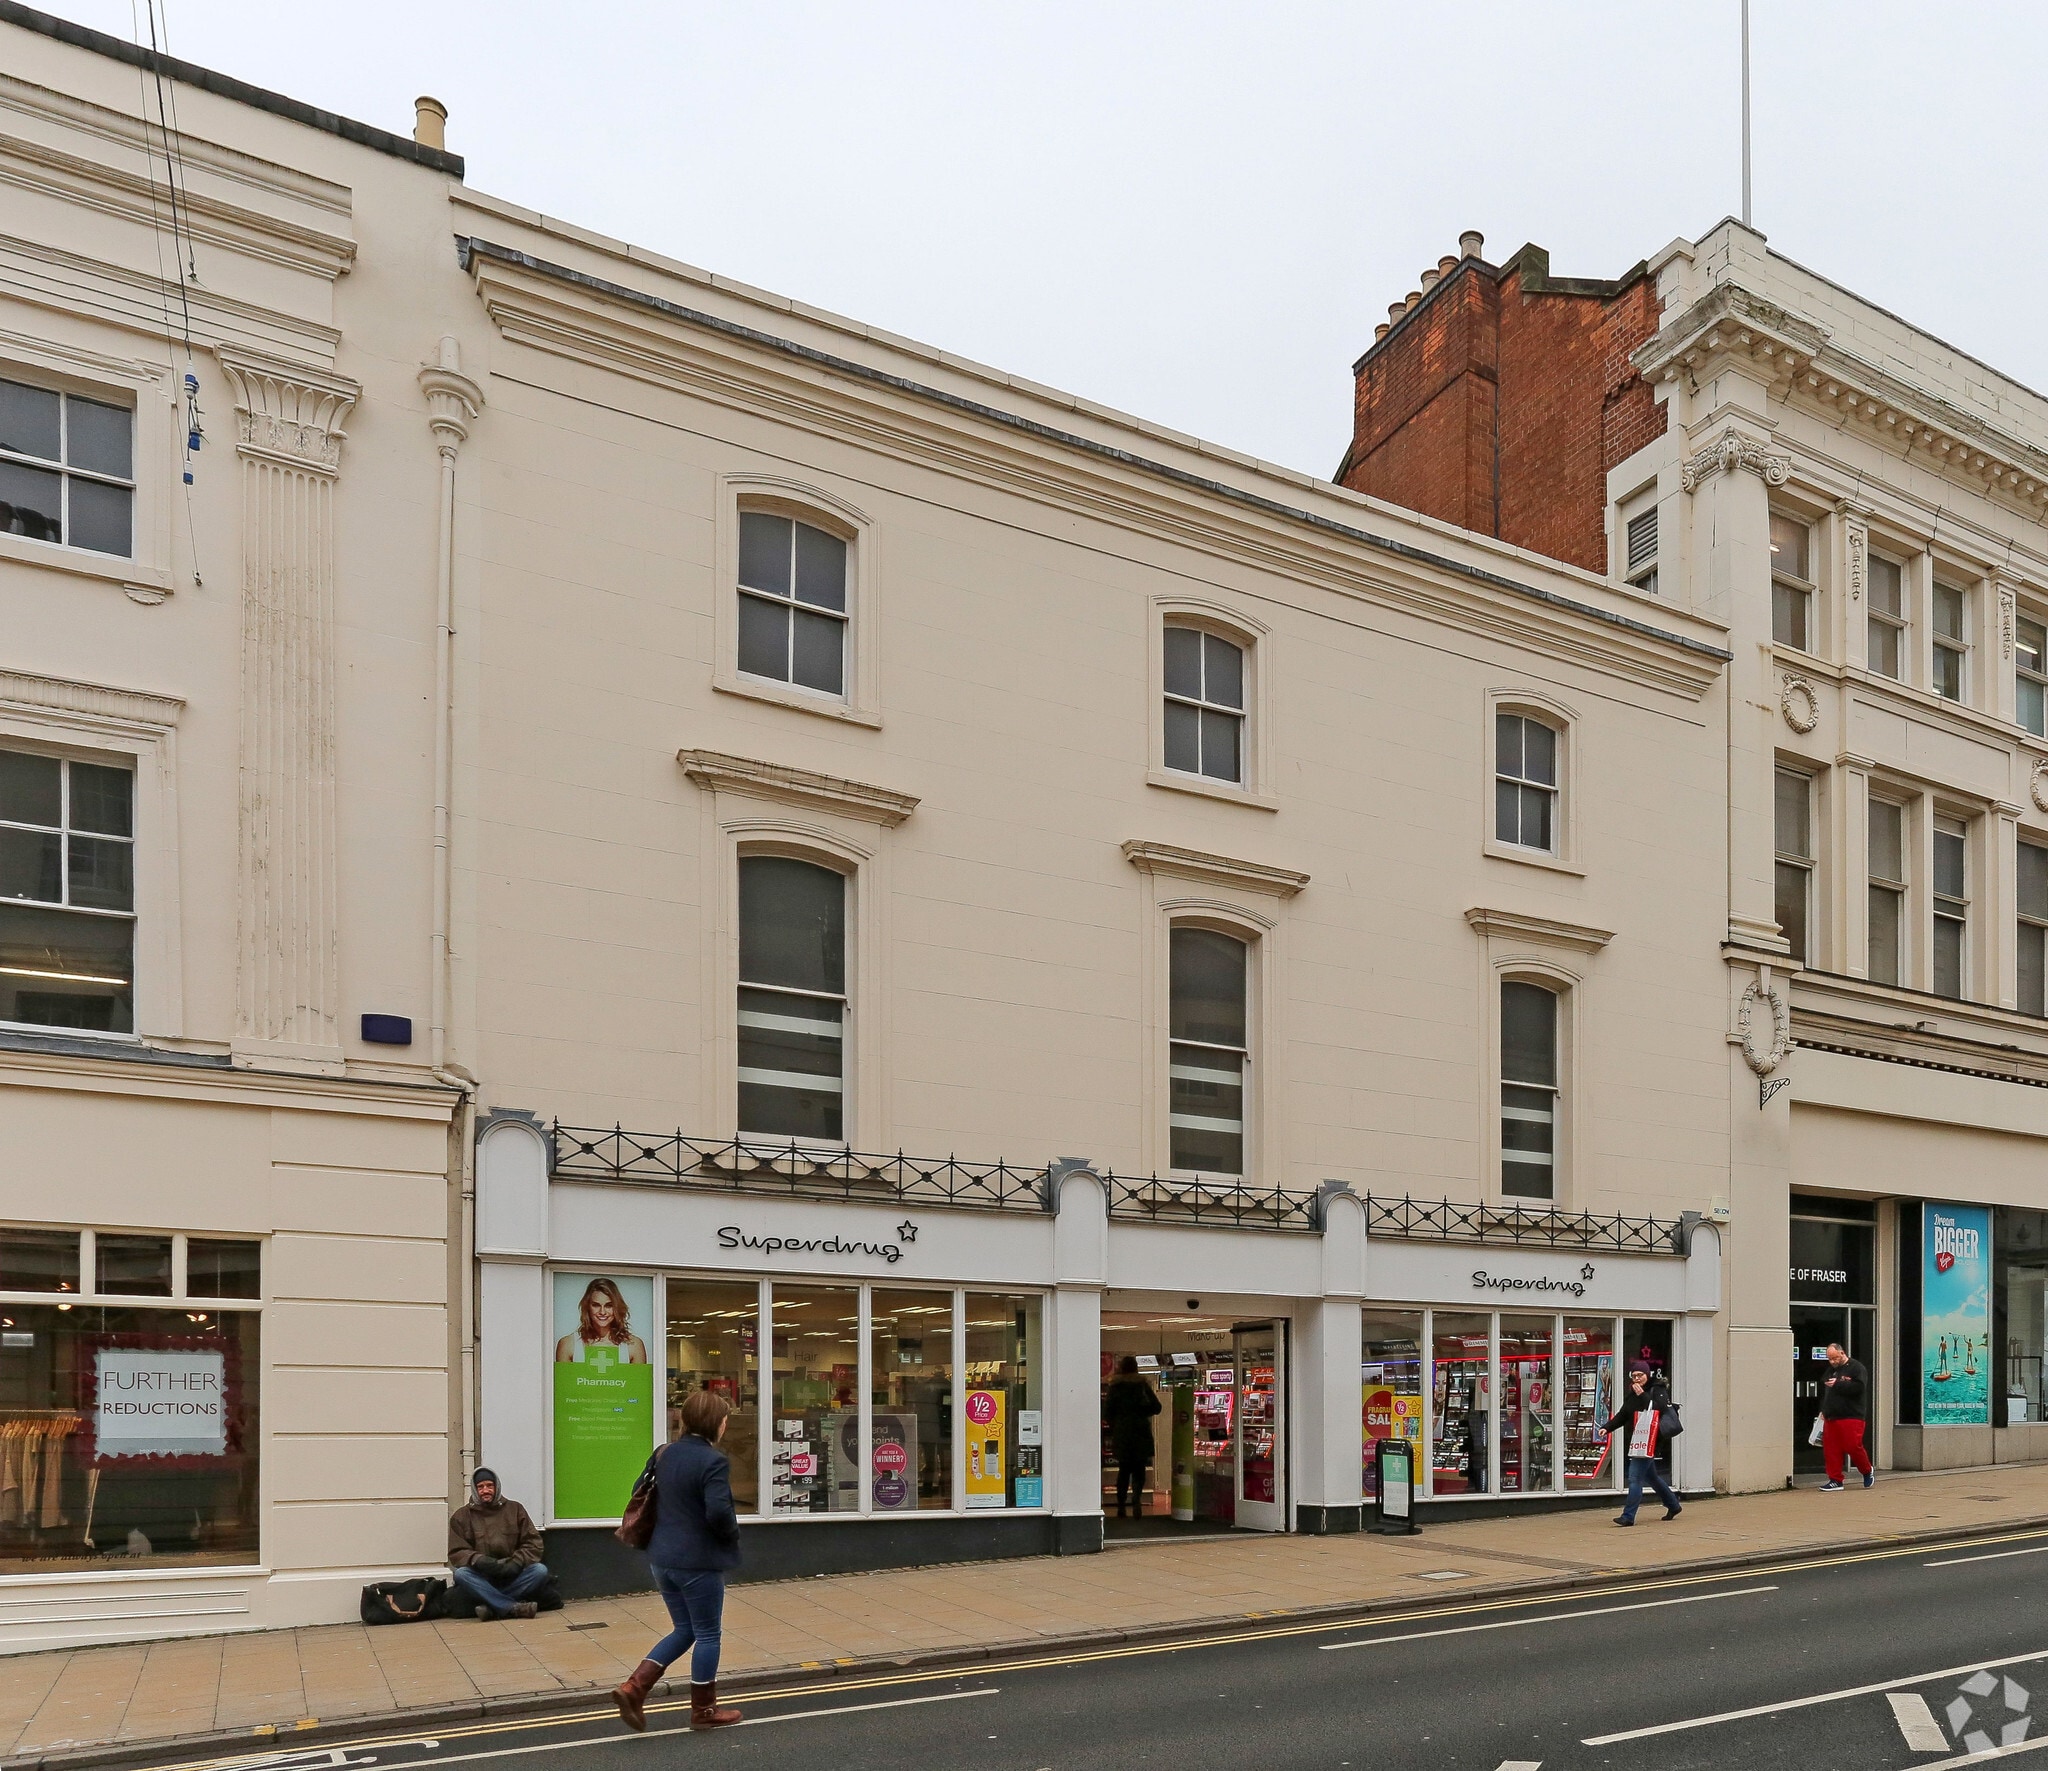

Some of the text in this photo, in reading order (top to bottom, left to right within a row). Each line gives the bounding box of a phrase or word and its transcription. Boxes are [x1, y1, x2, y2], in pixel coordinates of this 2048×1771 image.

[1934, 1214, 1955, 1226] Dream
[717, 1226, 903, 1263] Superdrug
[1934, 1226, 1979, 1259] BIGGER
[1797, 1268, 1810, 1281] OF
[1811, 1269, 1847, 1283] FRASER
[1472, 1271, 1586, 1297] Superdrug
[794, 1351, 818, 1361] Hair
[103, 1371, 219, 1391] FURTHER
[576, 1377, 627, 1388] Pharmacy
[103, 1403, 218, 1415] REDUCTIONS
[972, 1396, 990, 1413] 1/2
[1367, 1413, 1391, 1426] SAL
[1630, 1440, 1647, 1450] sale
[876, 1455, 904, 1463] WINNER?
